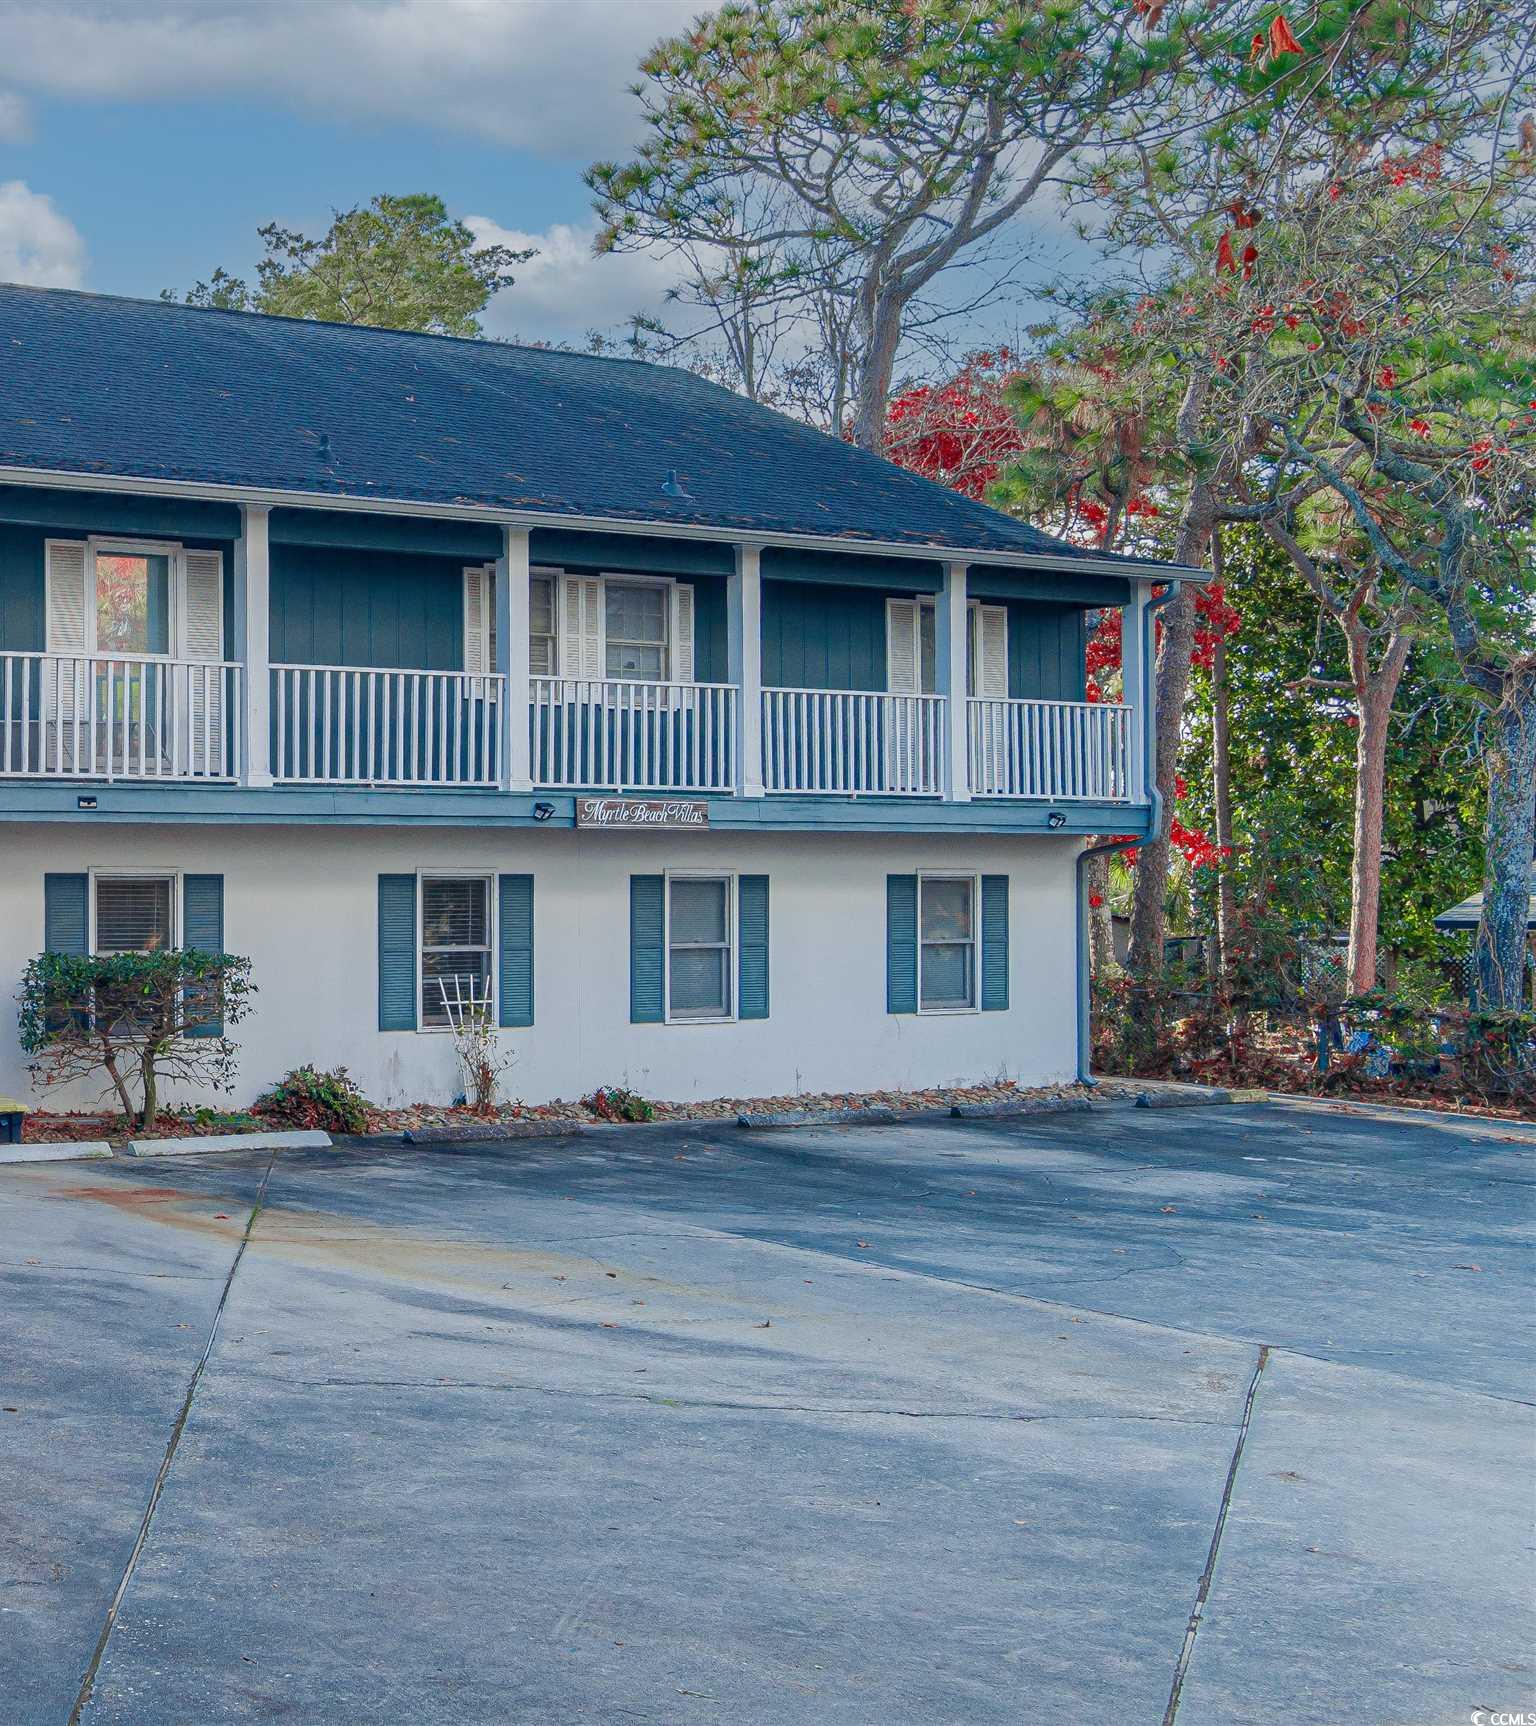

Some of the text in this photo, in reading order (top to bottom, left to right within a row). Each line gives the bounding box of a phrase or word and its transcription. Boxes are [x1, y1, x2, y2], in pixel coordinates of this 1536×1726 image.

[582, 800, 704, 825] Myrtle Beach Villas
